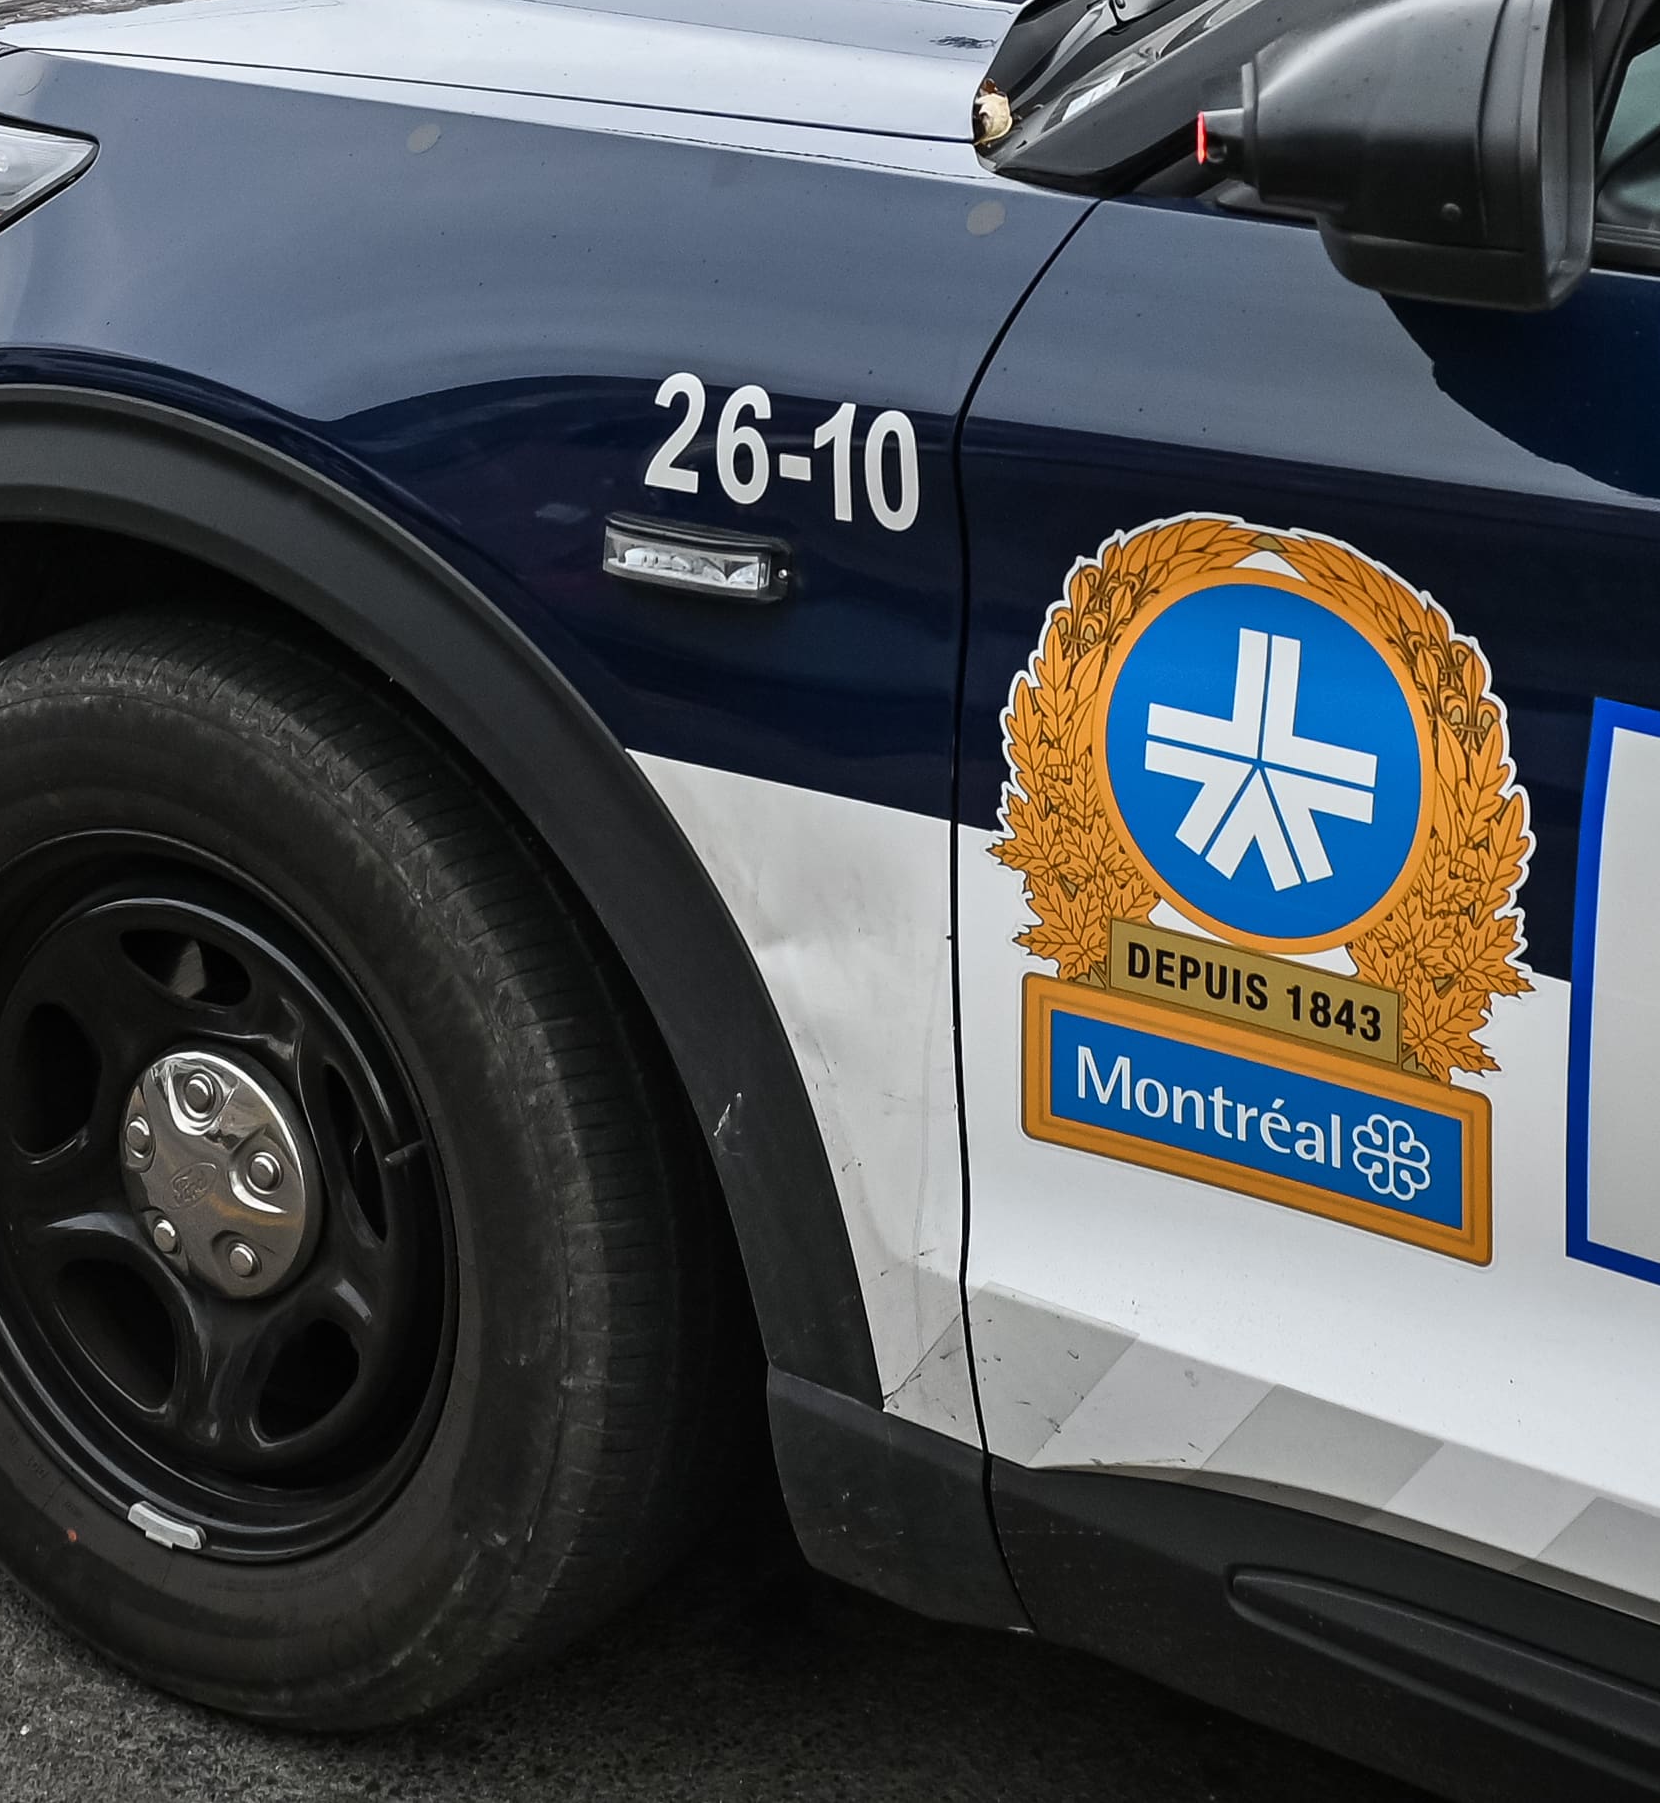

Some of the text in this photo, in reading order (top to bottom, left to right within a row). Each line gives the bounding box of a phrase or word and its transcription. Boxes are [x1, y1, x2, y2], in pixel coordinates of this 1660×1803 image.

[644, 371, 920, 533] 26-10
[1127, 941, 1383, 1043] DEPUIS 1843
[1075, 1044, 1342, 1169] Montréal
